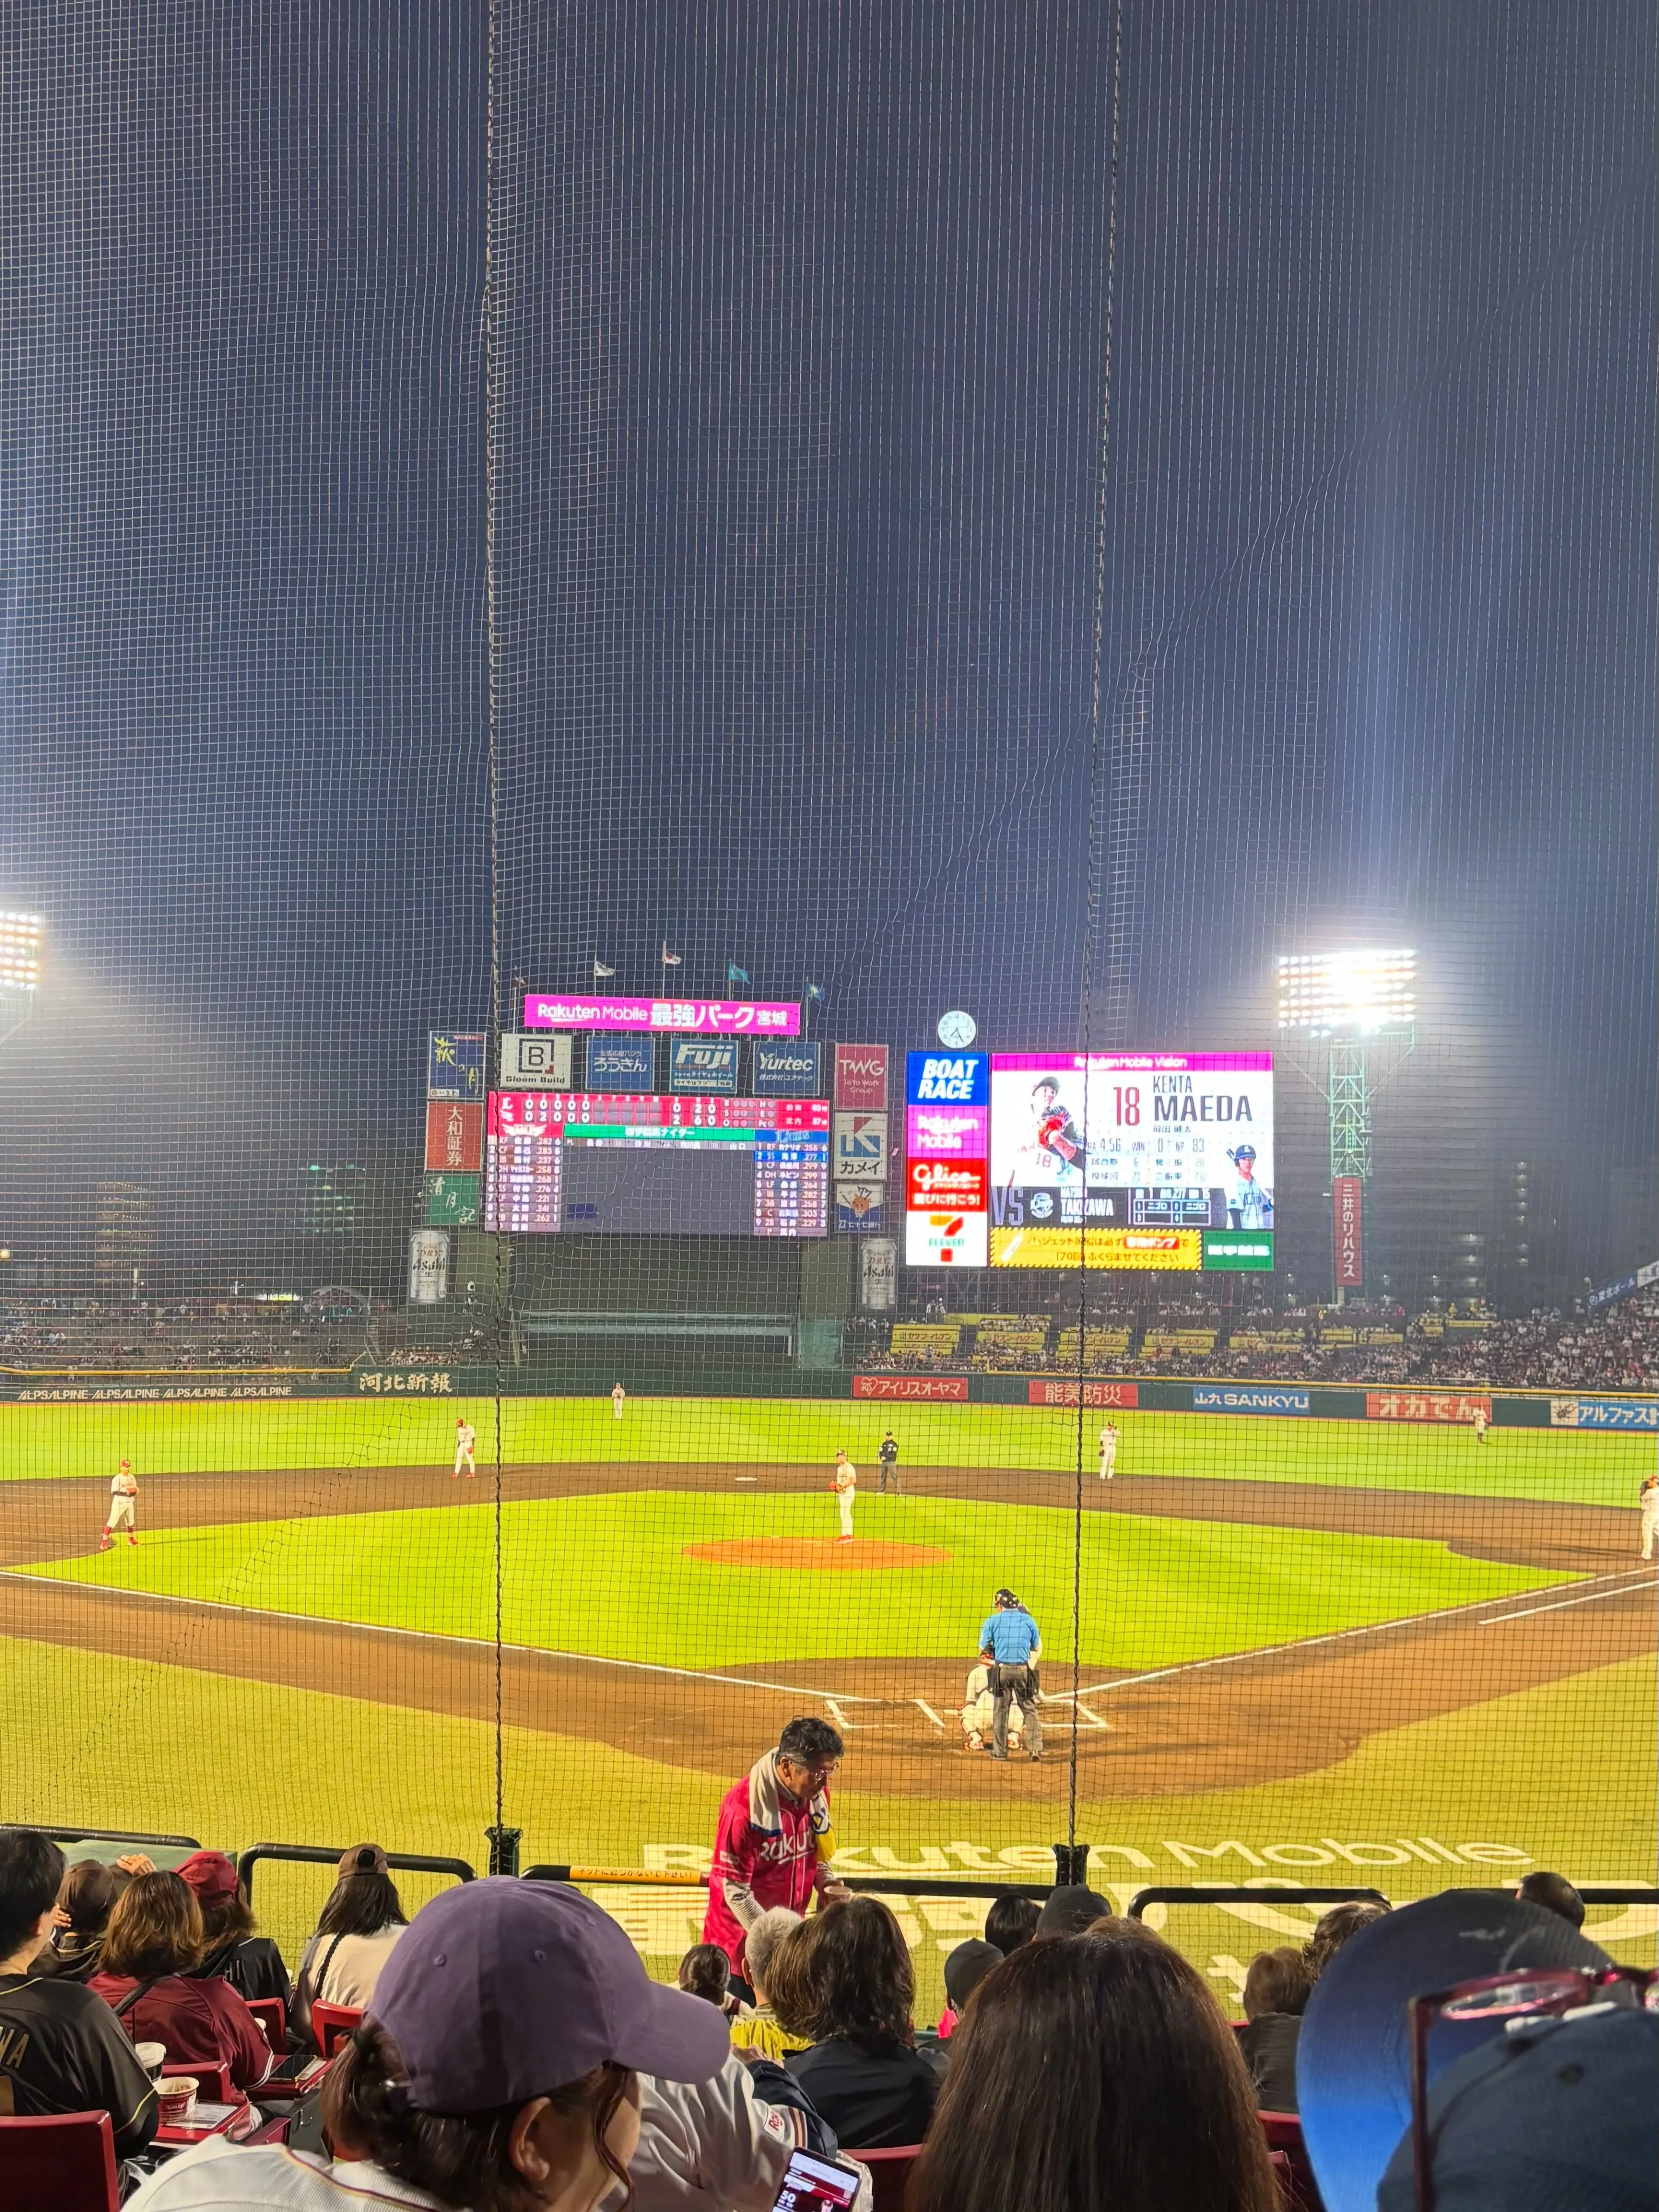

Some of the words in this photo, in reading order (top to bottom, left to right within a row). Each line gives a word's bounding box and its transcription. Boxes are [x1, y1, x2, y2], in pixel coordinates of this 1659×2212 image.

[538, 1004, 601, 1022] Rakuten
[602, 1006, 648, 1020] Mobile
[651, 1003, 755, 1028] 最強パーク
[757, 1010, 787, 1026] 宮城
[594, 1057, 647, 1071] ろうきん
[676, 1044, 733, 1069] Fuji
[760, 1053, 813, 1071] Yurtec
[1121, 1057, 1152, 1067] Mobile
[1156, 1057, 1186, 1068] Vision
[839, 1060, 884, 1076] TWG
[922, 1059, 979, 1079] BOAT
[918, 1079, 974, 1099] RACE
[1154, 1075, 1192, 1093] KENTA
[525, 1100, 533, 1110] 0
[540, 1100, 547, 1110] 0
[554, 1100, 562, 1110] 0
[568, 1101, 576, 1110] 0
[582, 1101, 590, 1110] 0
[673, 1103, 680, 1113] 0
[694, 1103, 702, 1114] 2
[708, 1103, 716, 1114] 0
[1114, 1087, 1140, 1126] 18
[1155, 1096, 1252, 1121] MAEDA
[525, 1110, 533, 1121] 0
[539, 1111, 547, 1121] 2
[554, 1111, 562, 1122] 0
[568, 1112, 576, 1123] 0
[582, 1112, 590, 1123] 0
[673, 1114, 680, 1125] 2
[694, 1115, 702, 1125] 6
[708, 1115, 716, 1126] 0
[447, 1106, 463, 1166] 大和証券
[918, 1135, 962, 1149] Mobile
[1100, 1138, 1121, 1153] 4.56
[1132, 1142, 1145, 1151] WIN
[1193, 1138, 1204, 1152] 83
[841, 1162, 880, 1175] カメイ
[428, 1176, 476, 1224] 清月記
[914, 1193, 980, 1205] びに行こう!
[991, 1186, 1023, 1225] VS
[1343, 1184, 1354, 1277] 三井のリハウス
[413, 1257, 445, 1270] Asahi
[864, 1264, 894, 1277] Asahi
[359, 1373, 452, 1393] 河北新報
[879, 1381, 961, 1396] アイリスオーヤマ
[1045, 1382, 1122, 1405] 能美防災
[1195, 1392, 1222, 1404] 山九
[1224, 1394, 1309, 1408] SANKYU
[643, 1840, 1154, 1878] Rkuten
[1162, 1837, 1535, 1867] Mobile
